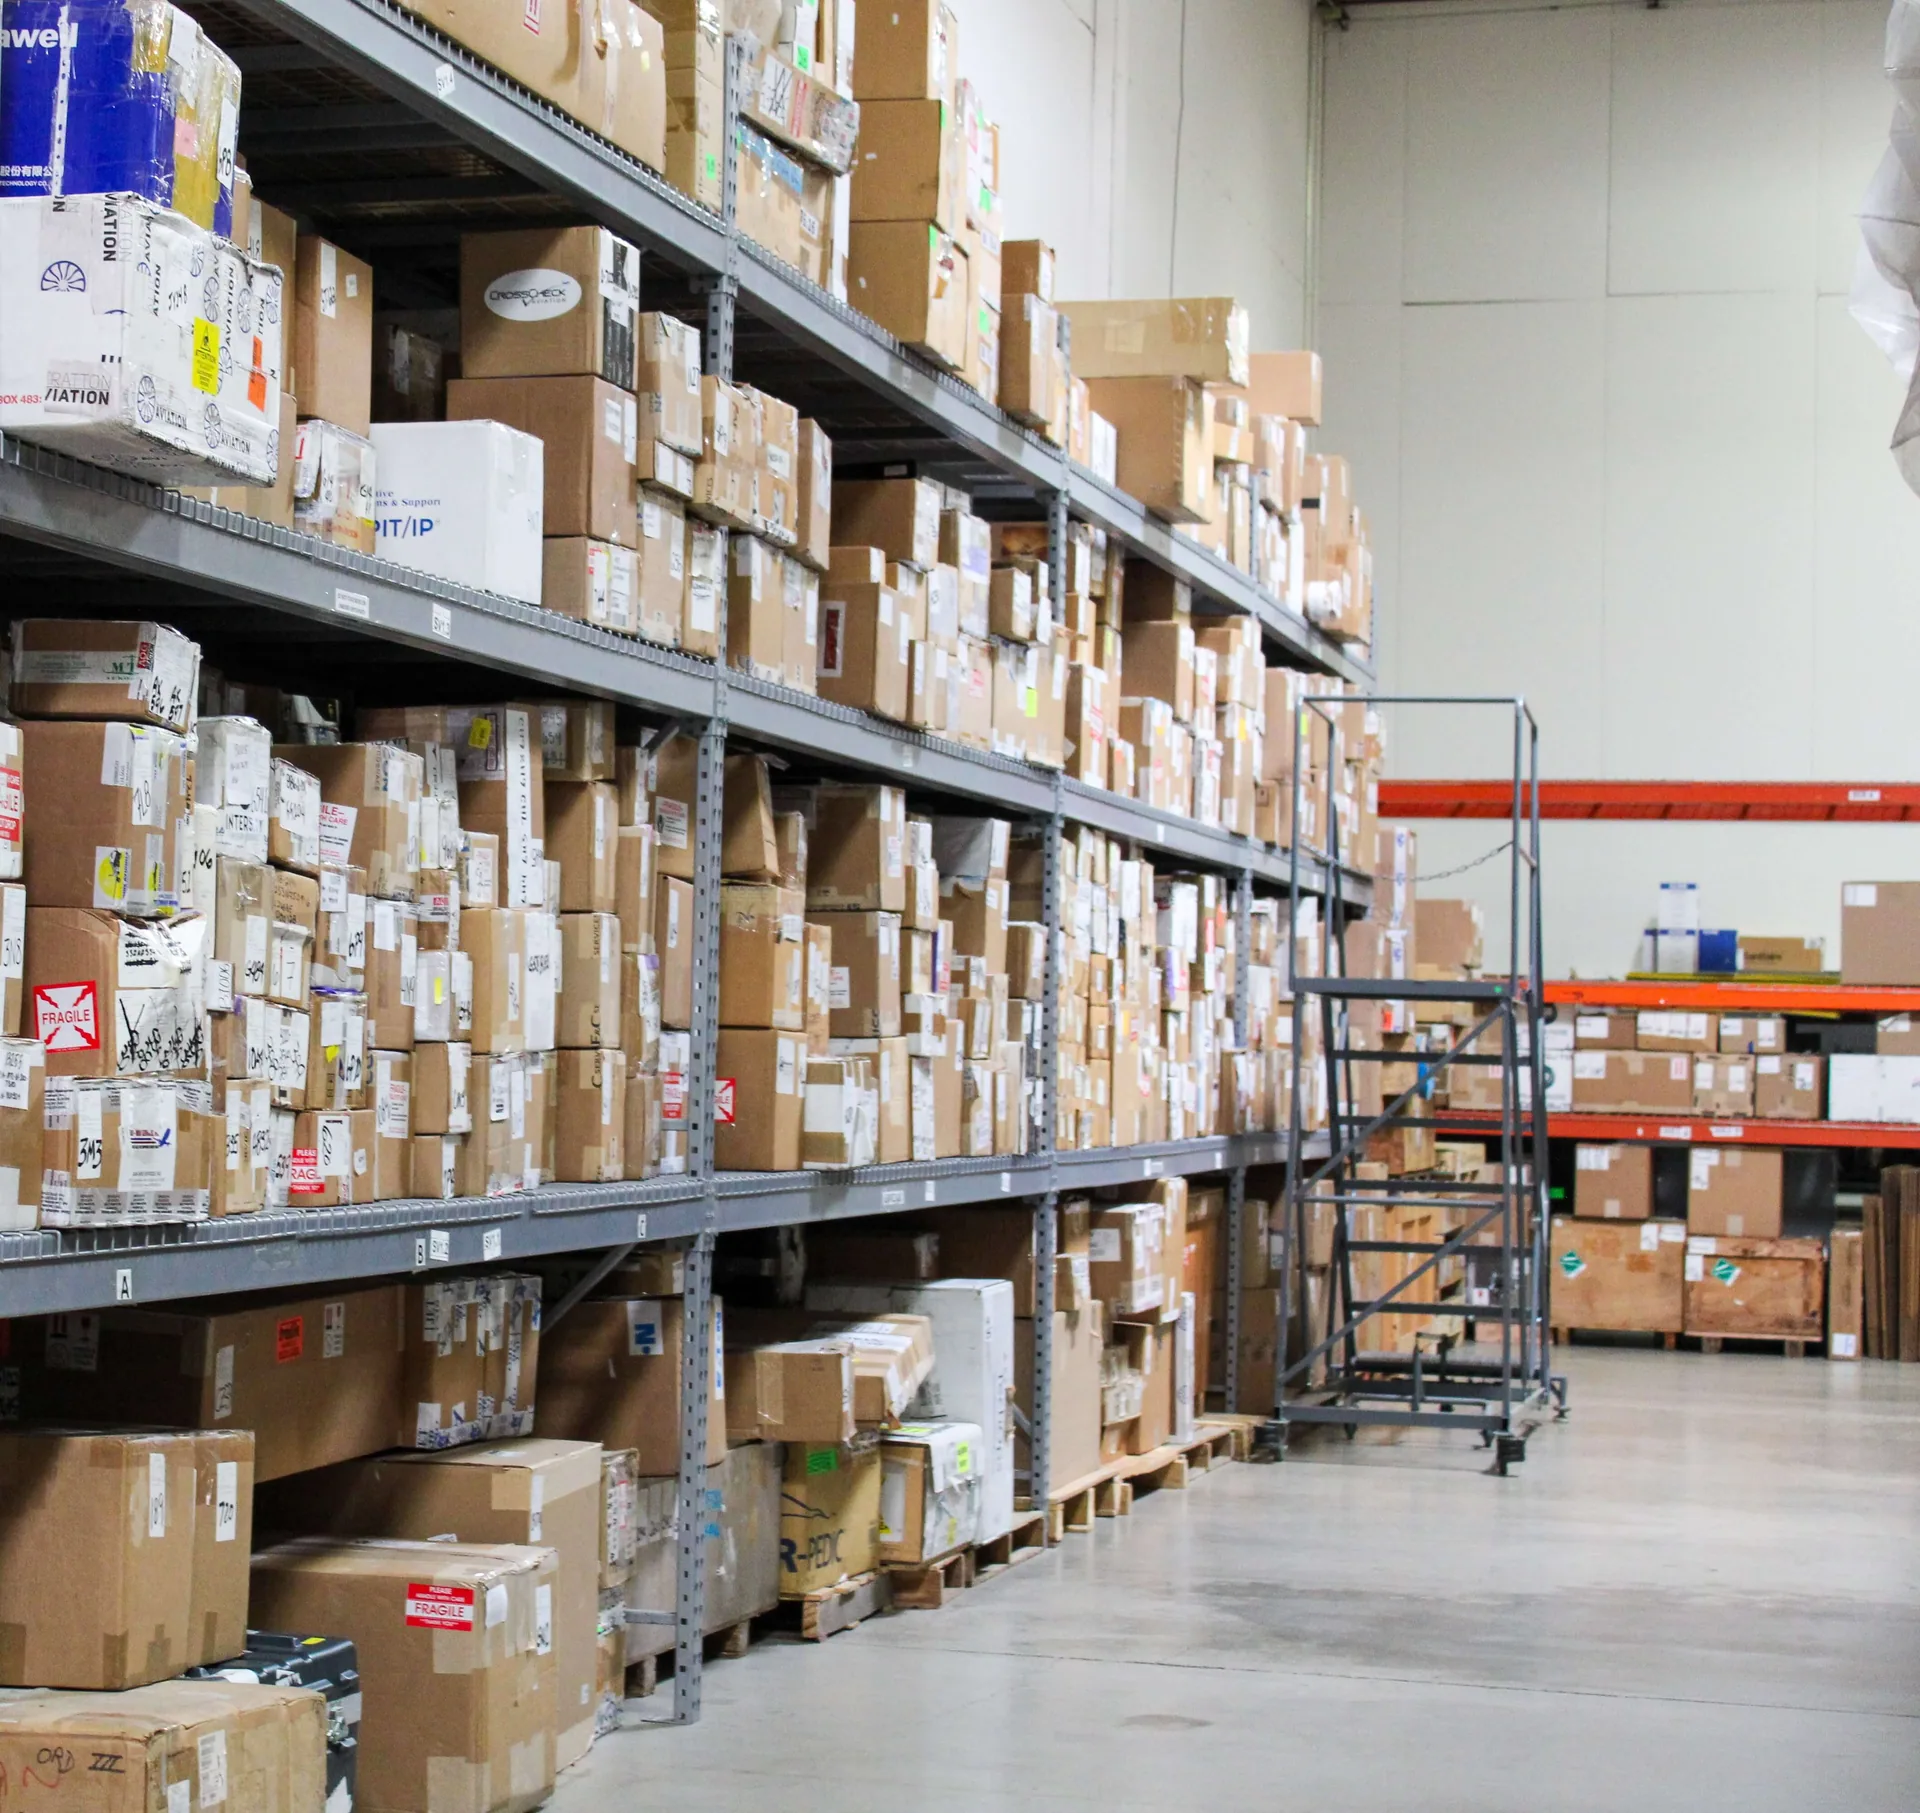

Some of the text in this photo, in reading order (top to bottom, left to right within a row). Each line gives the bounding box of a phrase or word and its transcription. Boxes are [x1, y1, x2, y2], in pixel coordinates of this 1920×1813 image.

[52, 194, 66, 212] N
[225, 266, 235, 350] AVIATION
[156, 405, 187, 430] AVIATION
[42, 1008, 91, 1025] FRAGILE
[120, 1275, 129, 1298] A
[429, 1586, 453, 1595] PLEASE
[414, 1602, 465, 1618] FRAGILE
